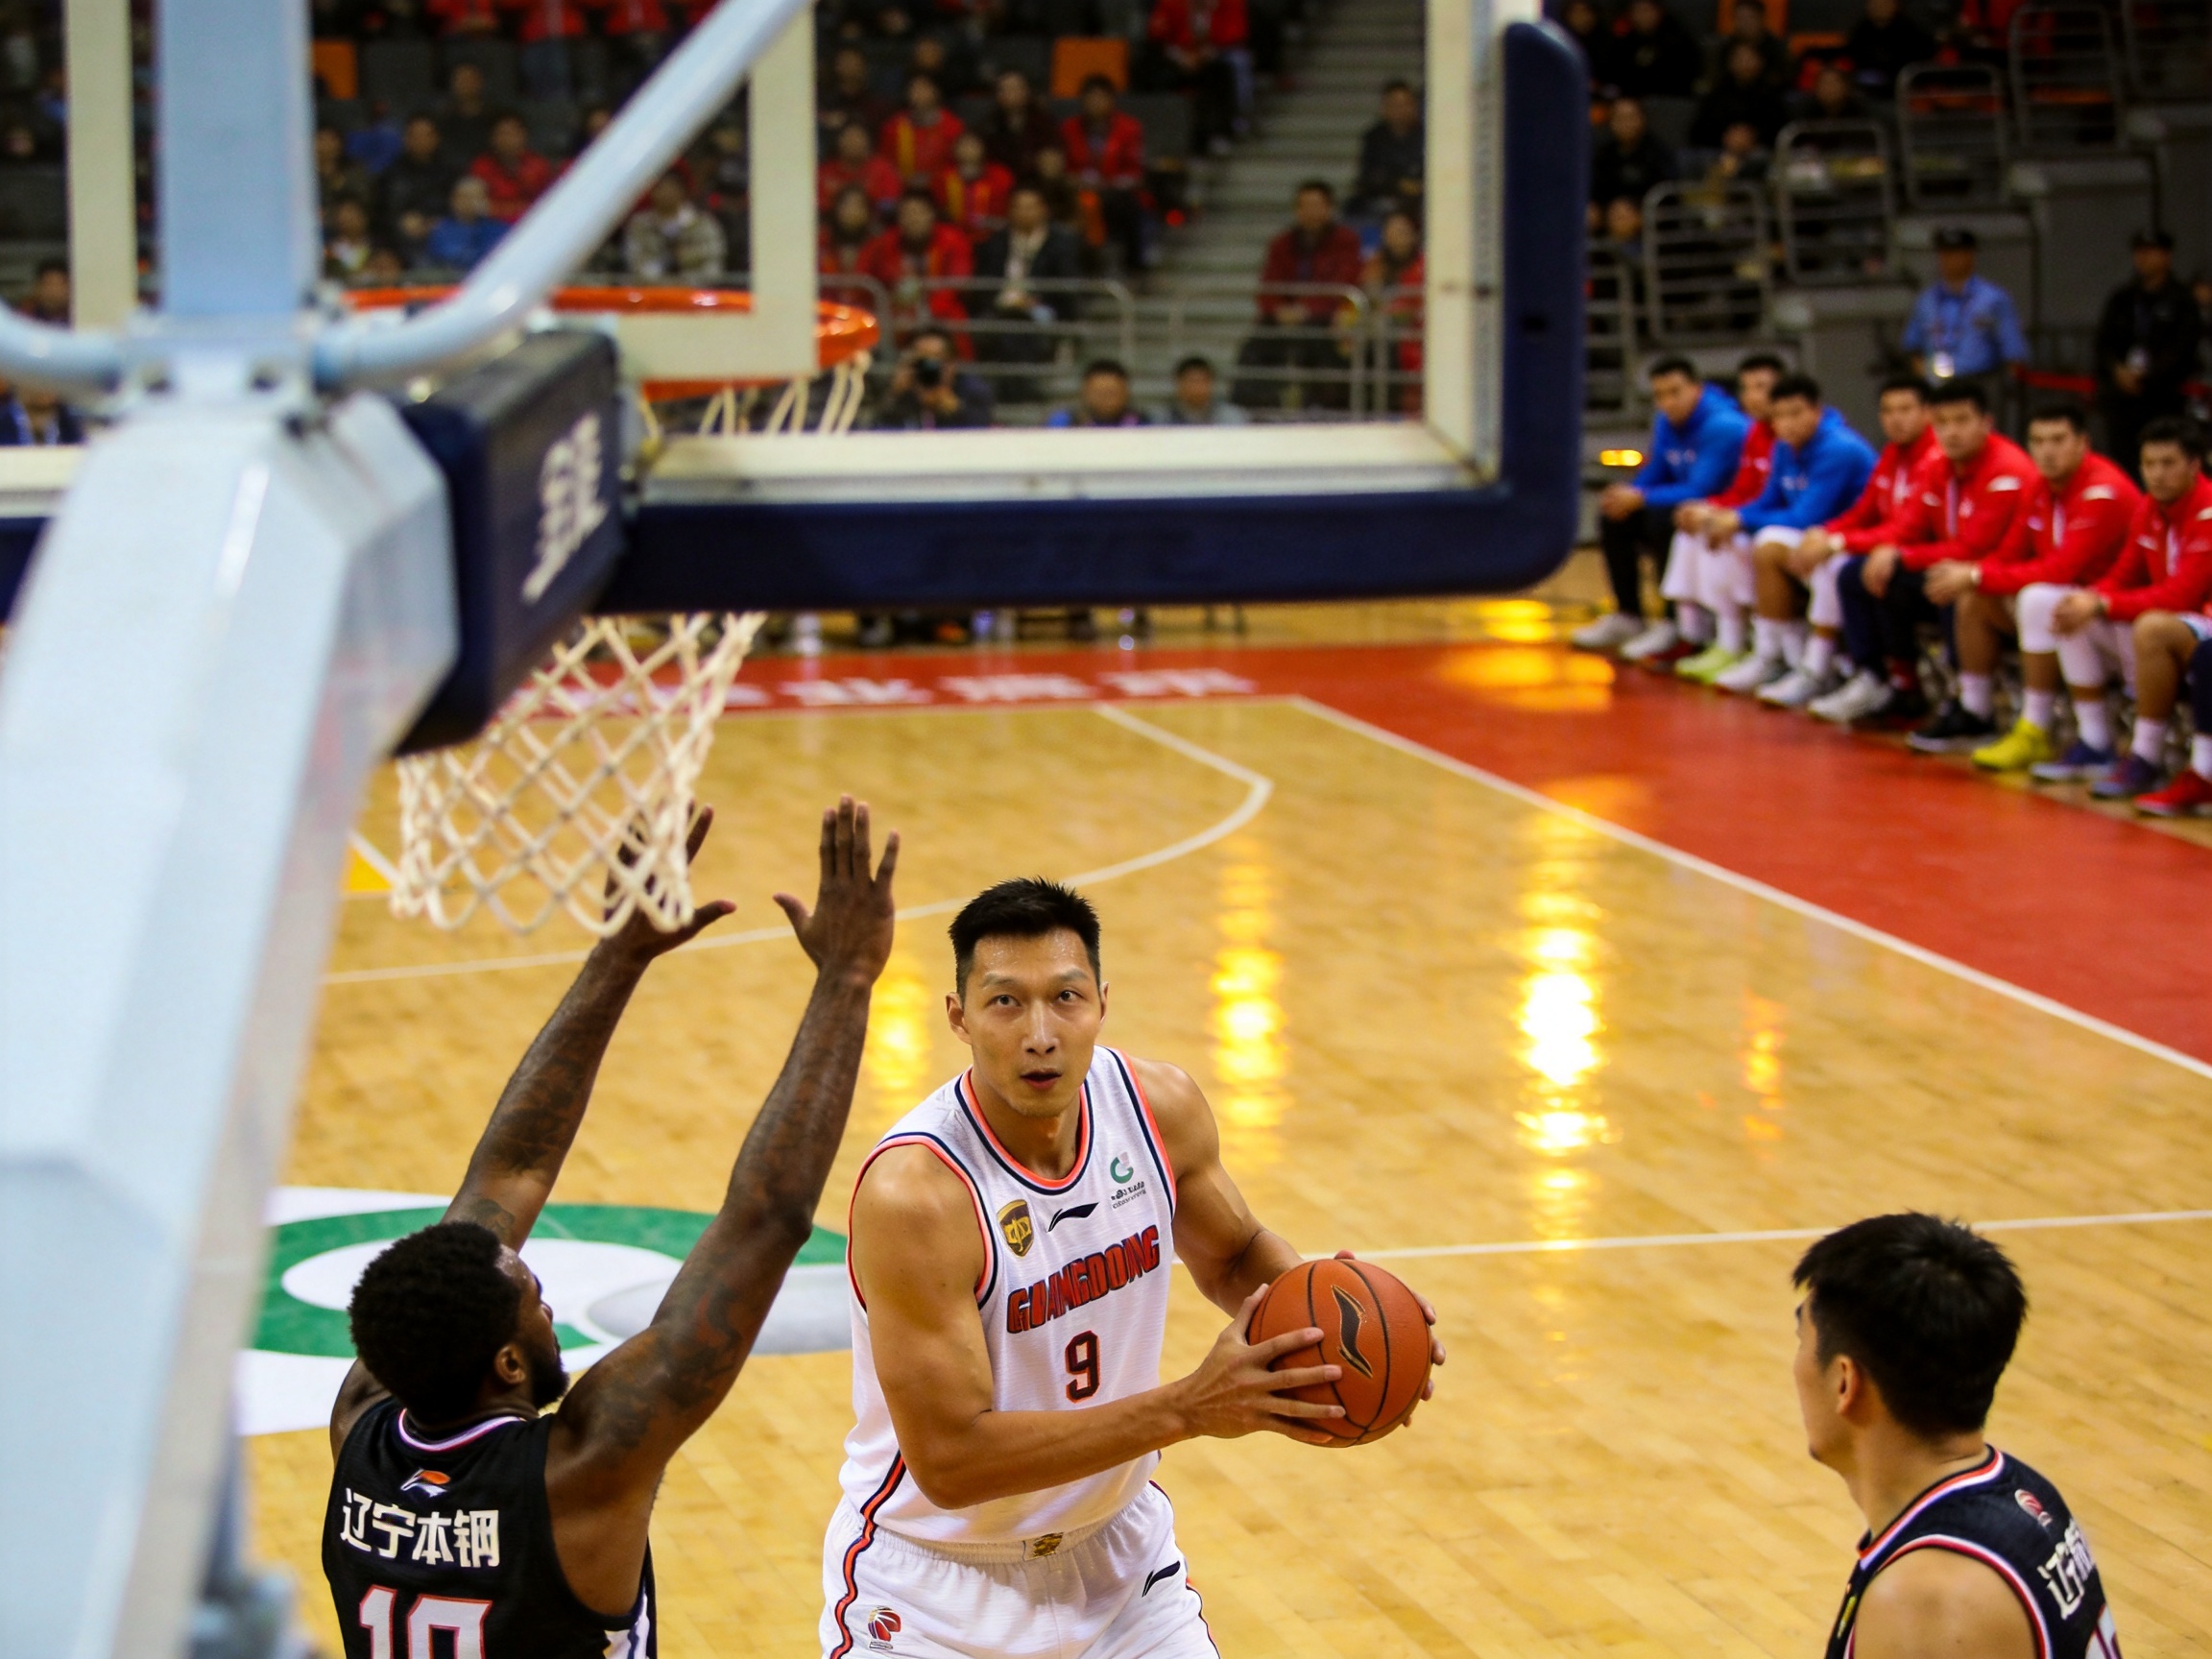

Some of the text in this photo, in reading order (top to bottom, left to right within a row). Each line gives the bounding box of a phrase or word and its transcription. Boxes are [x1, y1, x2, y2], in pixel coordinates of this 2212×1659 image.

[1007, 1224, 1160, 1334] GUANGDONG
[1065, 1330, 1101, 1404] 9
[340, 1488, 499, 1568] 辽宁本钢
